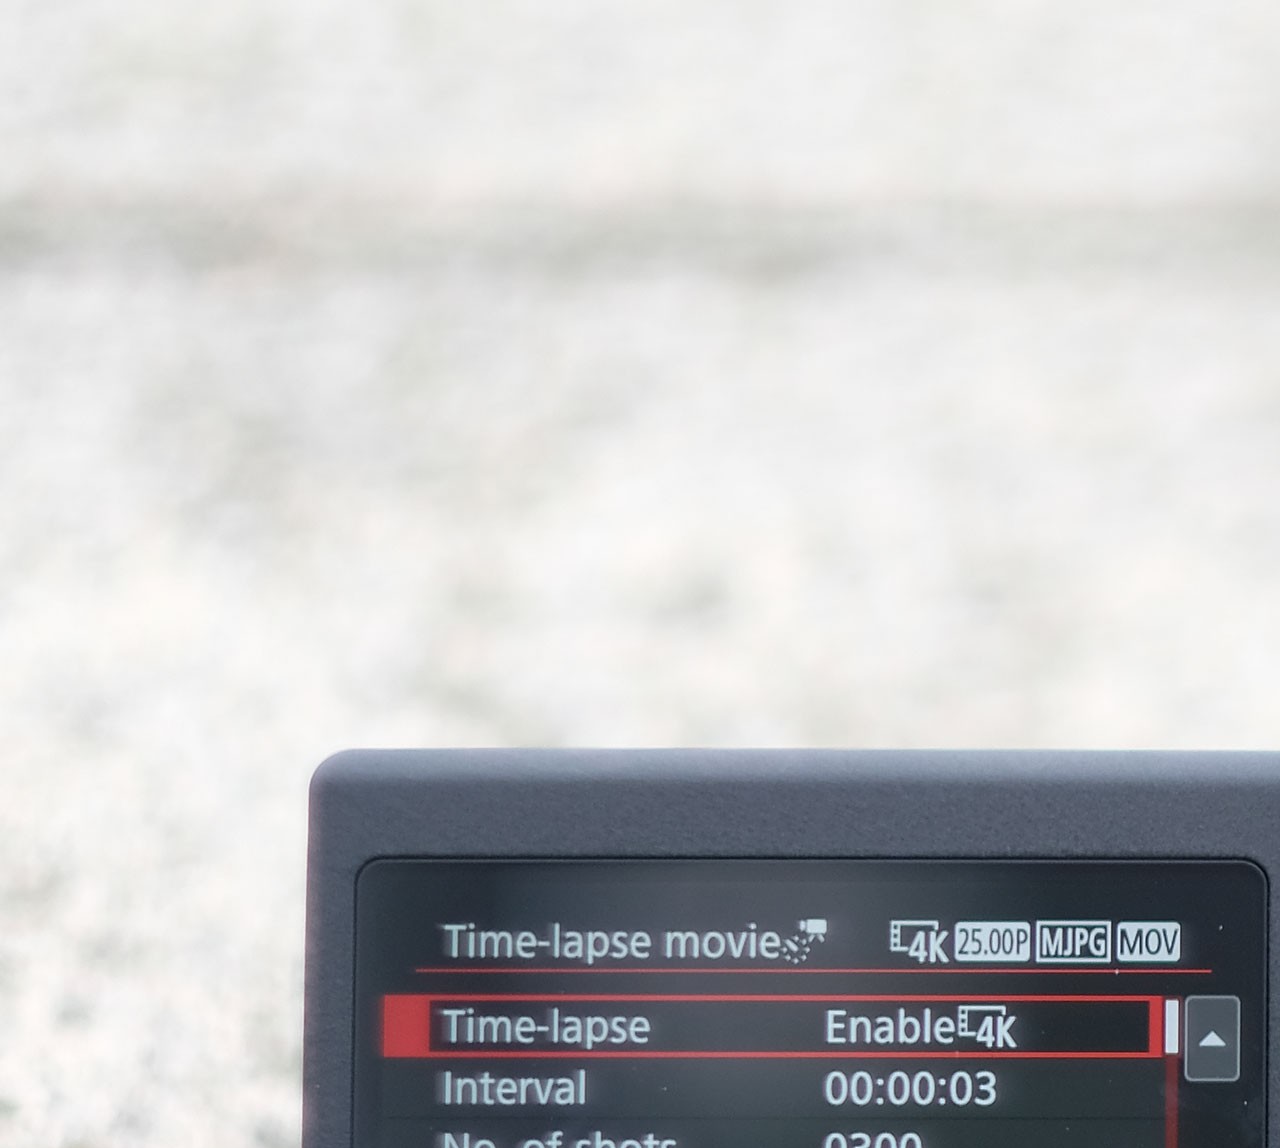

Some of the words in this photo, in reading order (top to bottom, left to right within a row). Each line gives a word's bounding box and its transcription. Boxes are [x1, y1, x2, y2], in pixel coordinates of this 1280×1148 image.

[443, 922, 651, 965] Time-lapse
[665, 923, 781, 958] movie
[908, 929, 949, 963] 4K
[957, 928, 1028, 956] 25.00P
[1040, 927, 1107, 957] MJPG
[1119, 928, 1179, 956] MOV
[443, 1008, 651, 1050] Time-lapse
[826, 1008, 956, 1044] Enable
[976, 1015, 1018, 1048] 4K
[443, 1069, 587, 1105] Interval
[825, 1071, 998, 1106] 00:00:03
